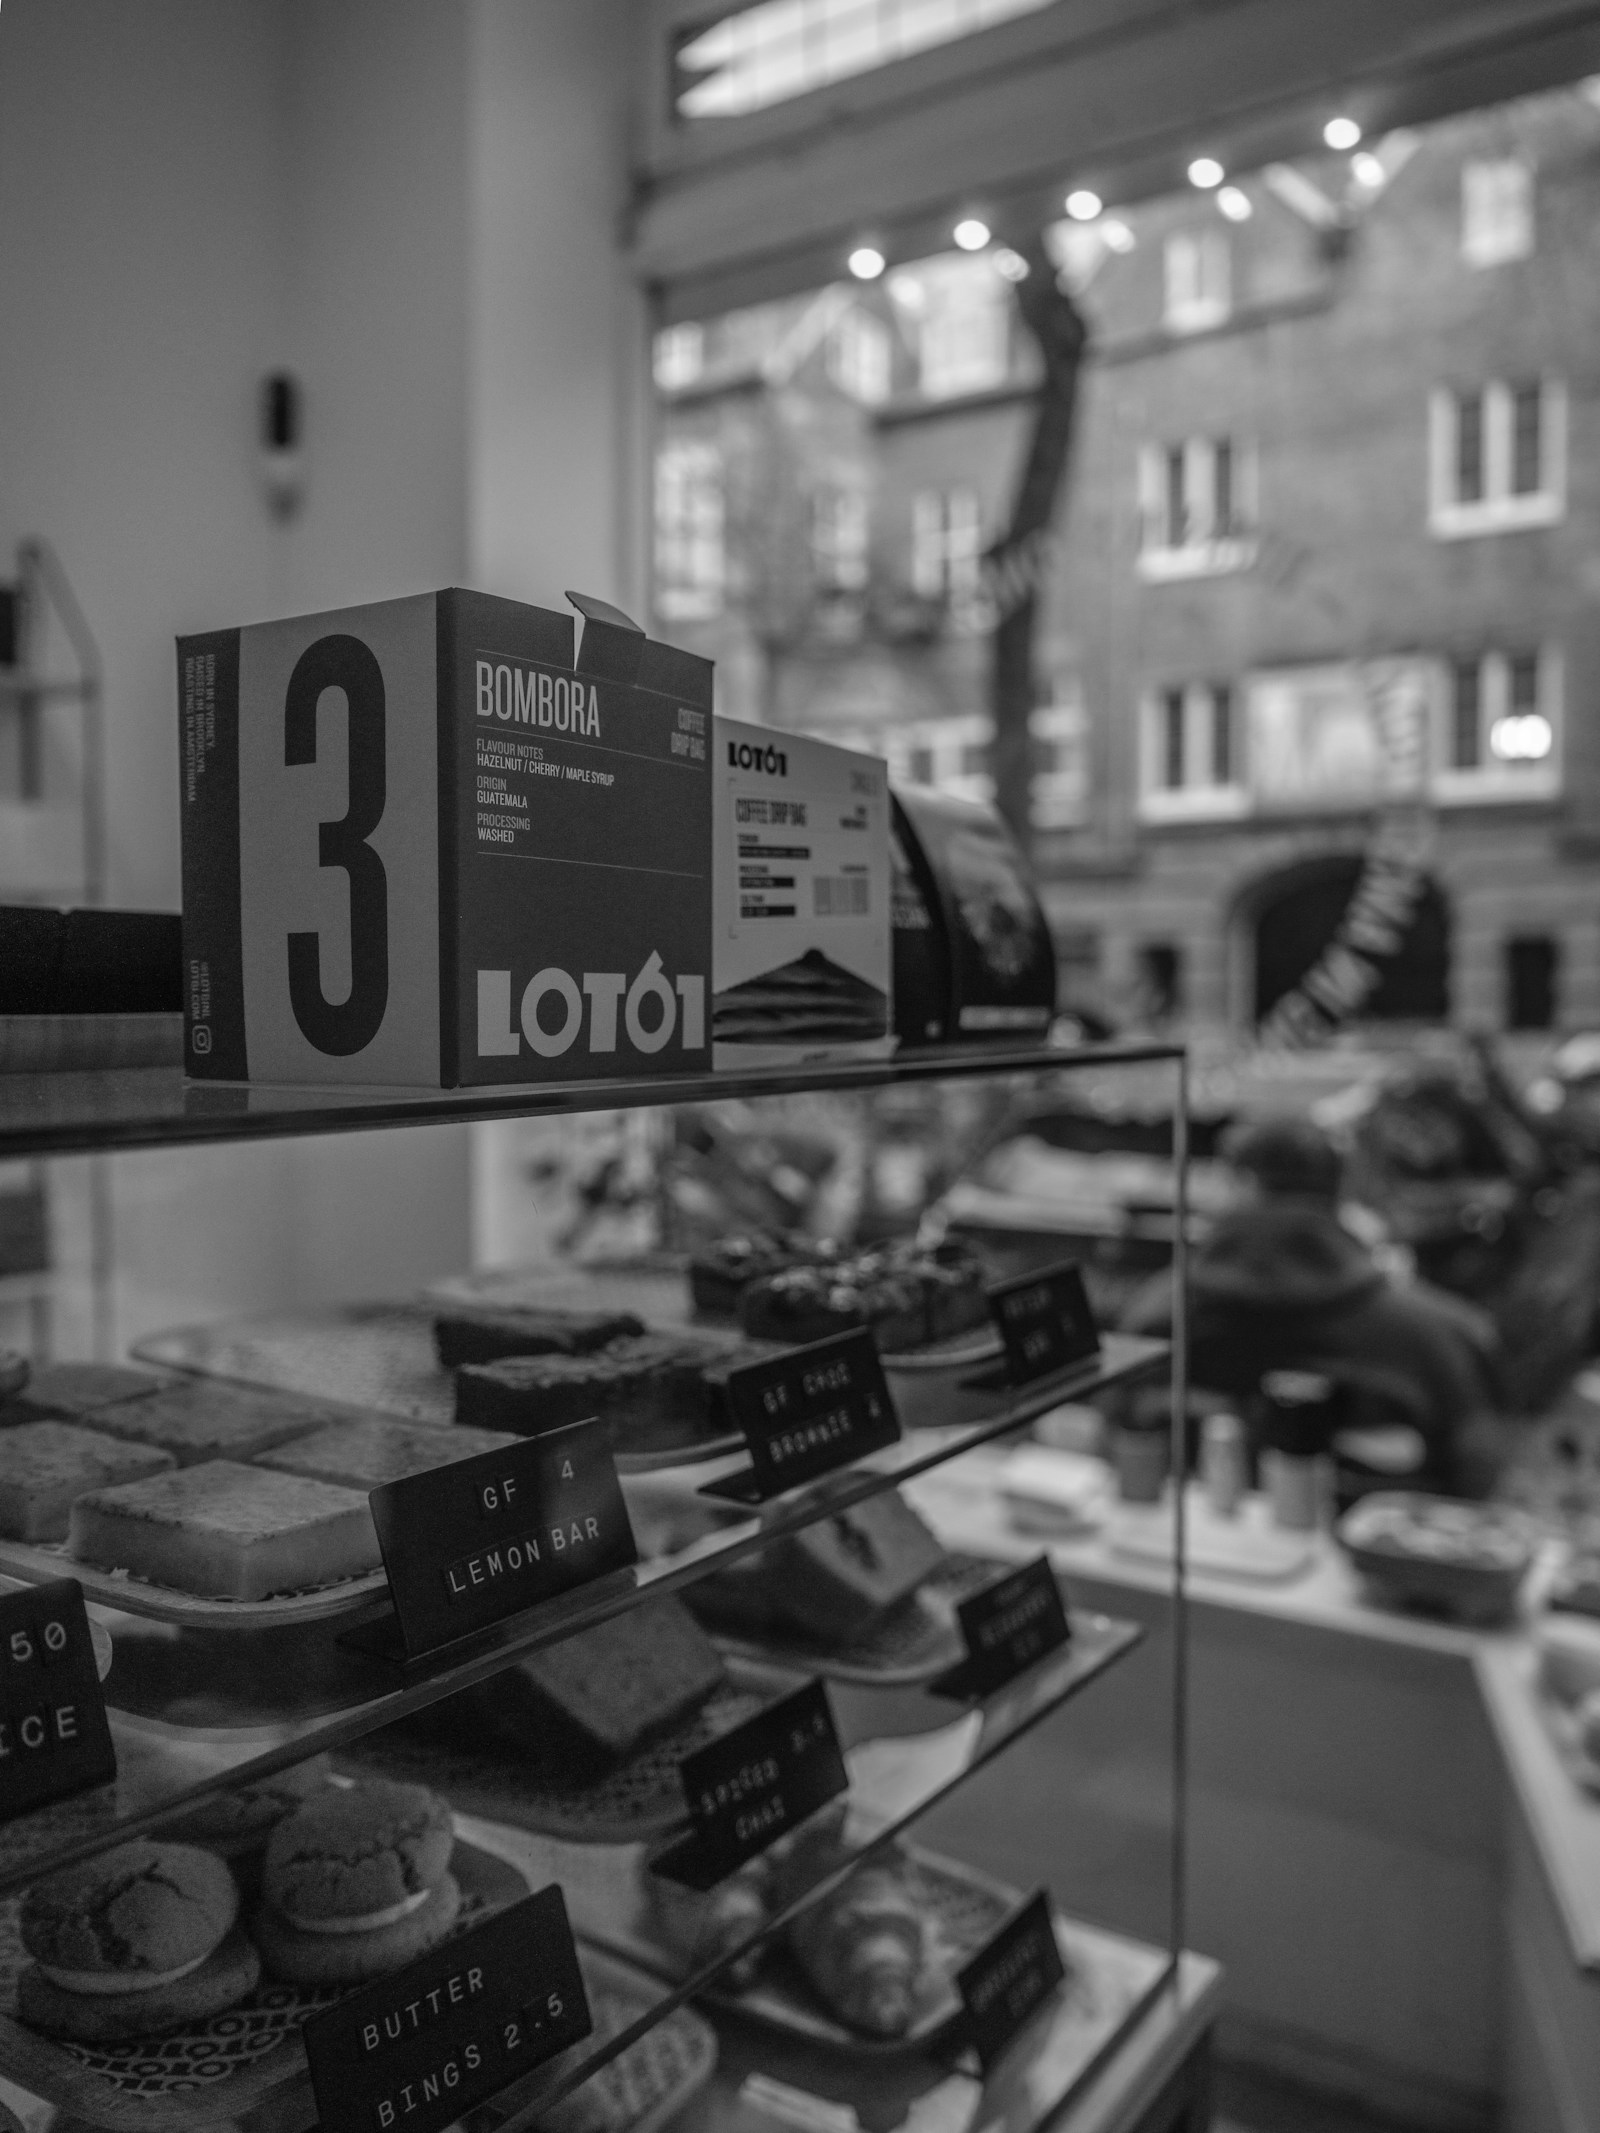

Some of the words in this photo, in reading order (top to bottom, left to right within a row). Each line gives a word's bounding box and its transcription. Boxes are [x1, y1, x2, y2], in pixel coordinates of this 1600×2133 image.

[195, 656, 205, 696] RAISED
[206, 653, 215, 686] BORN
[195, 698, 205, 711] IN
[206, 688, 215, 701] IN
[476, 660, 601, 738] BOMBORA
[476, 738, 516, 755] FLAVOUR
[517, 745, 544, 761] NOTES
[476, 776, 507, 791] ORIGIN
[477, 753, 522, 771] HAZELNUT
[529, 761, 561, 778] CHERRY
[566, 767, 591, 783] MAPLE
[591, 771, 615, 787] SYRUP
[477, 790, 528, 809] GUATEMALA
[477, 812, 531, 831] PROCESSING
[478, 827, 515, 844] WASHED
[284, 633, 388, 1057] 3
[483, 1478, 516, 1510] GF
[561, 1459, 575, 1480] 4
[449, 1538, 541, 1594] LEMON
[551, 1516, 600, 1551] BAR
[363, 1966, 485, 2051] BUTTER
[377, 2044, 482, 2128] BINGS
[503, 1992, 564, 2050] 2.5
